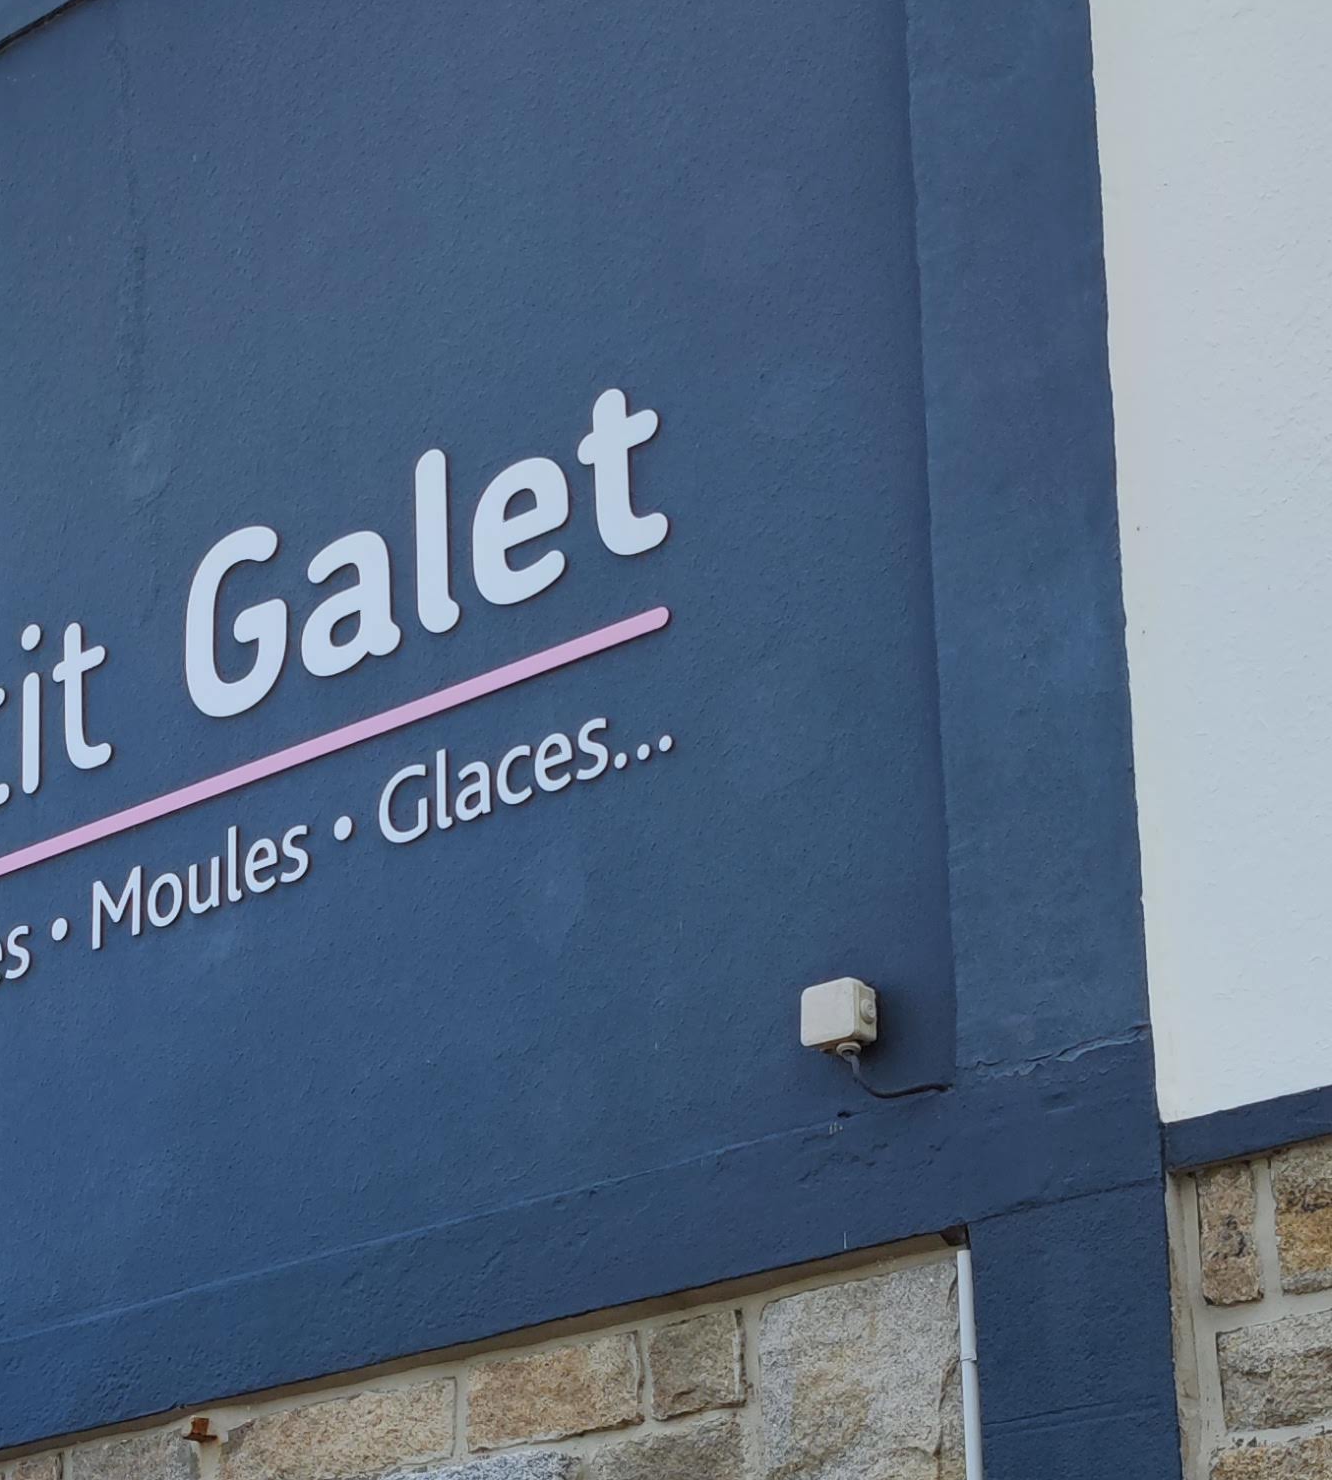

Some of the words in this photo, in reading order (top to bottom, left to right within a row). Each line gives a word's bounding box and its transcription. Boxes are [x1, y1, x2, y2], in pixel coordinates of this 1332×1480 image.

[186, 387, 669, 718] Galet
[89, 822, 310, 950] Moules
[377, 716, 674, 846] Glaces...
